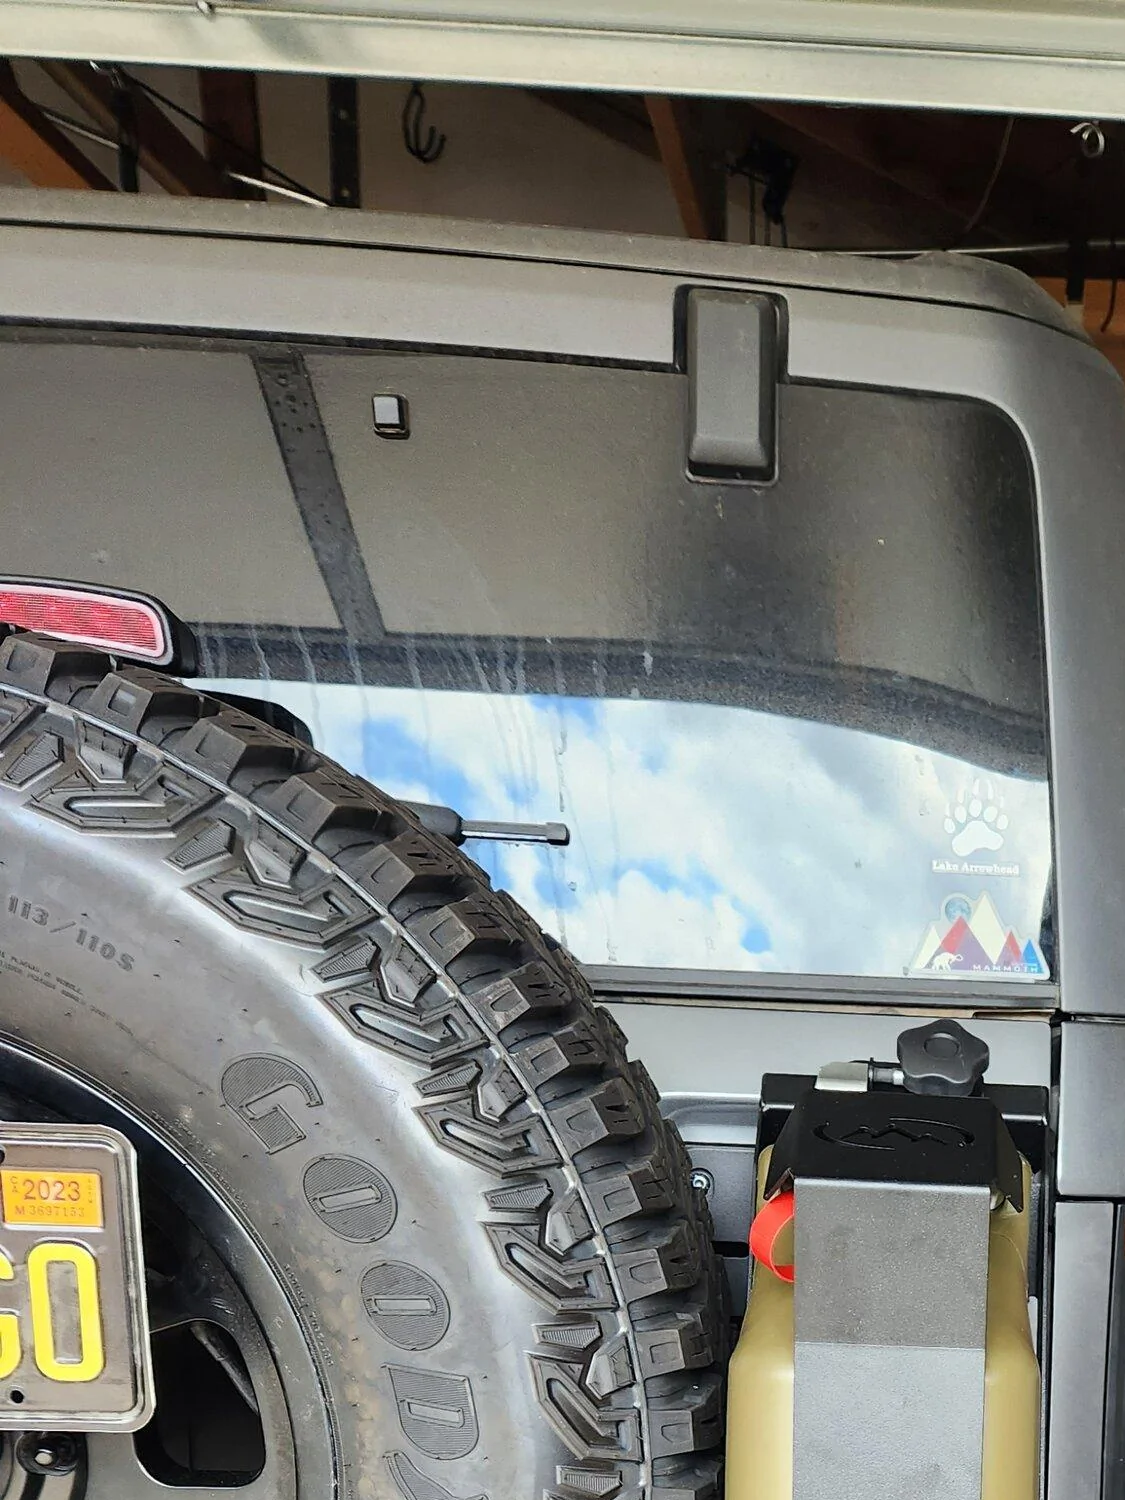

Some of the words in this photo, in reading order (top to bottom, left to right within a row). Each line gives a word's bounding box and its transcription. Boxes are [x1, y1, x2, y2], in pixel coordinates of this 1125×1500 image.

[932, 859, 959, 873] Lake
[962, 862, 1020, 876] Arrowhead
[973, 963, 1039, 974] MAMMOTH
[22, 1179, 81, 1202] 2023
